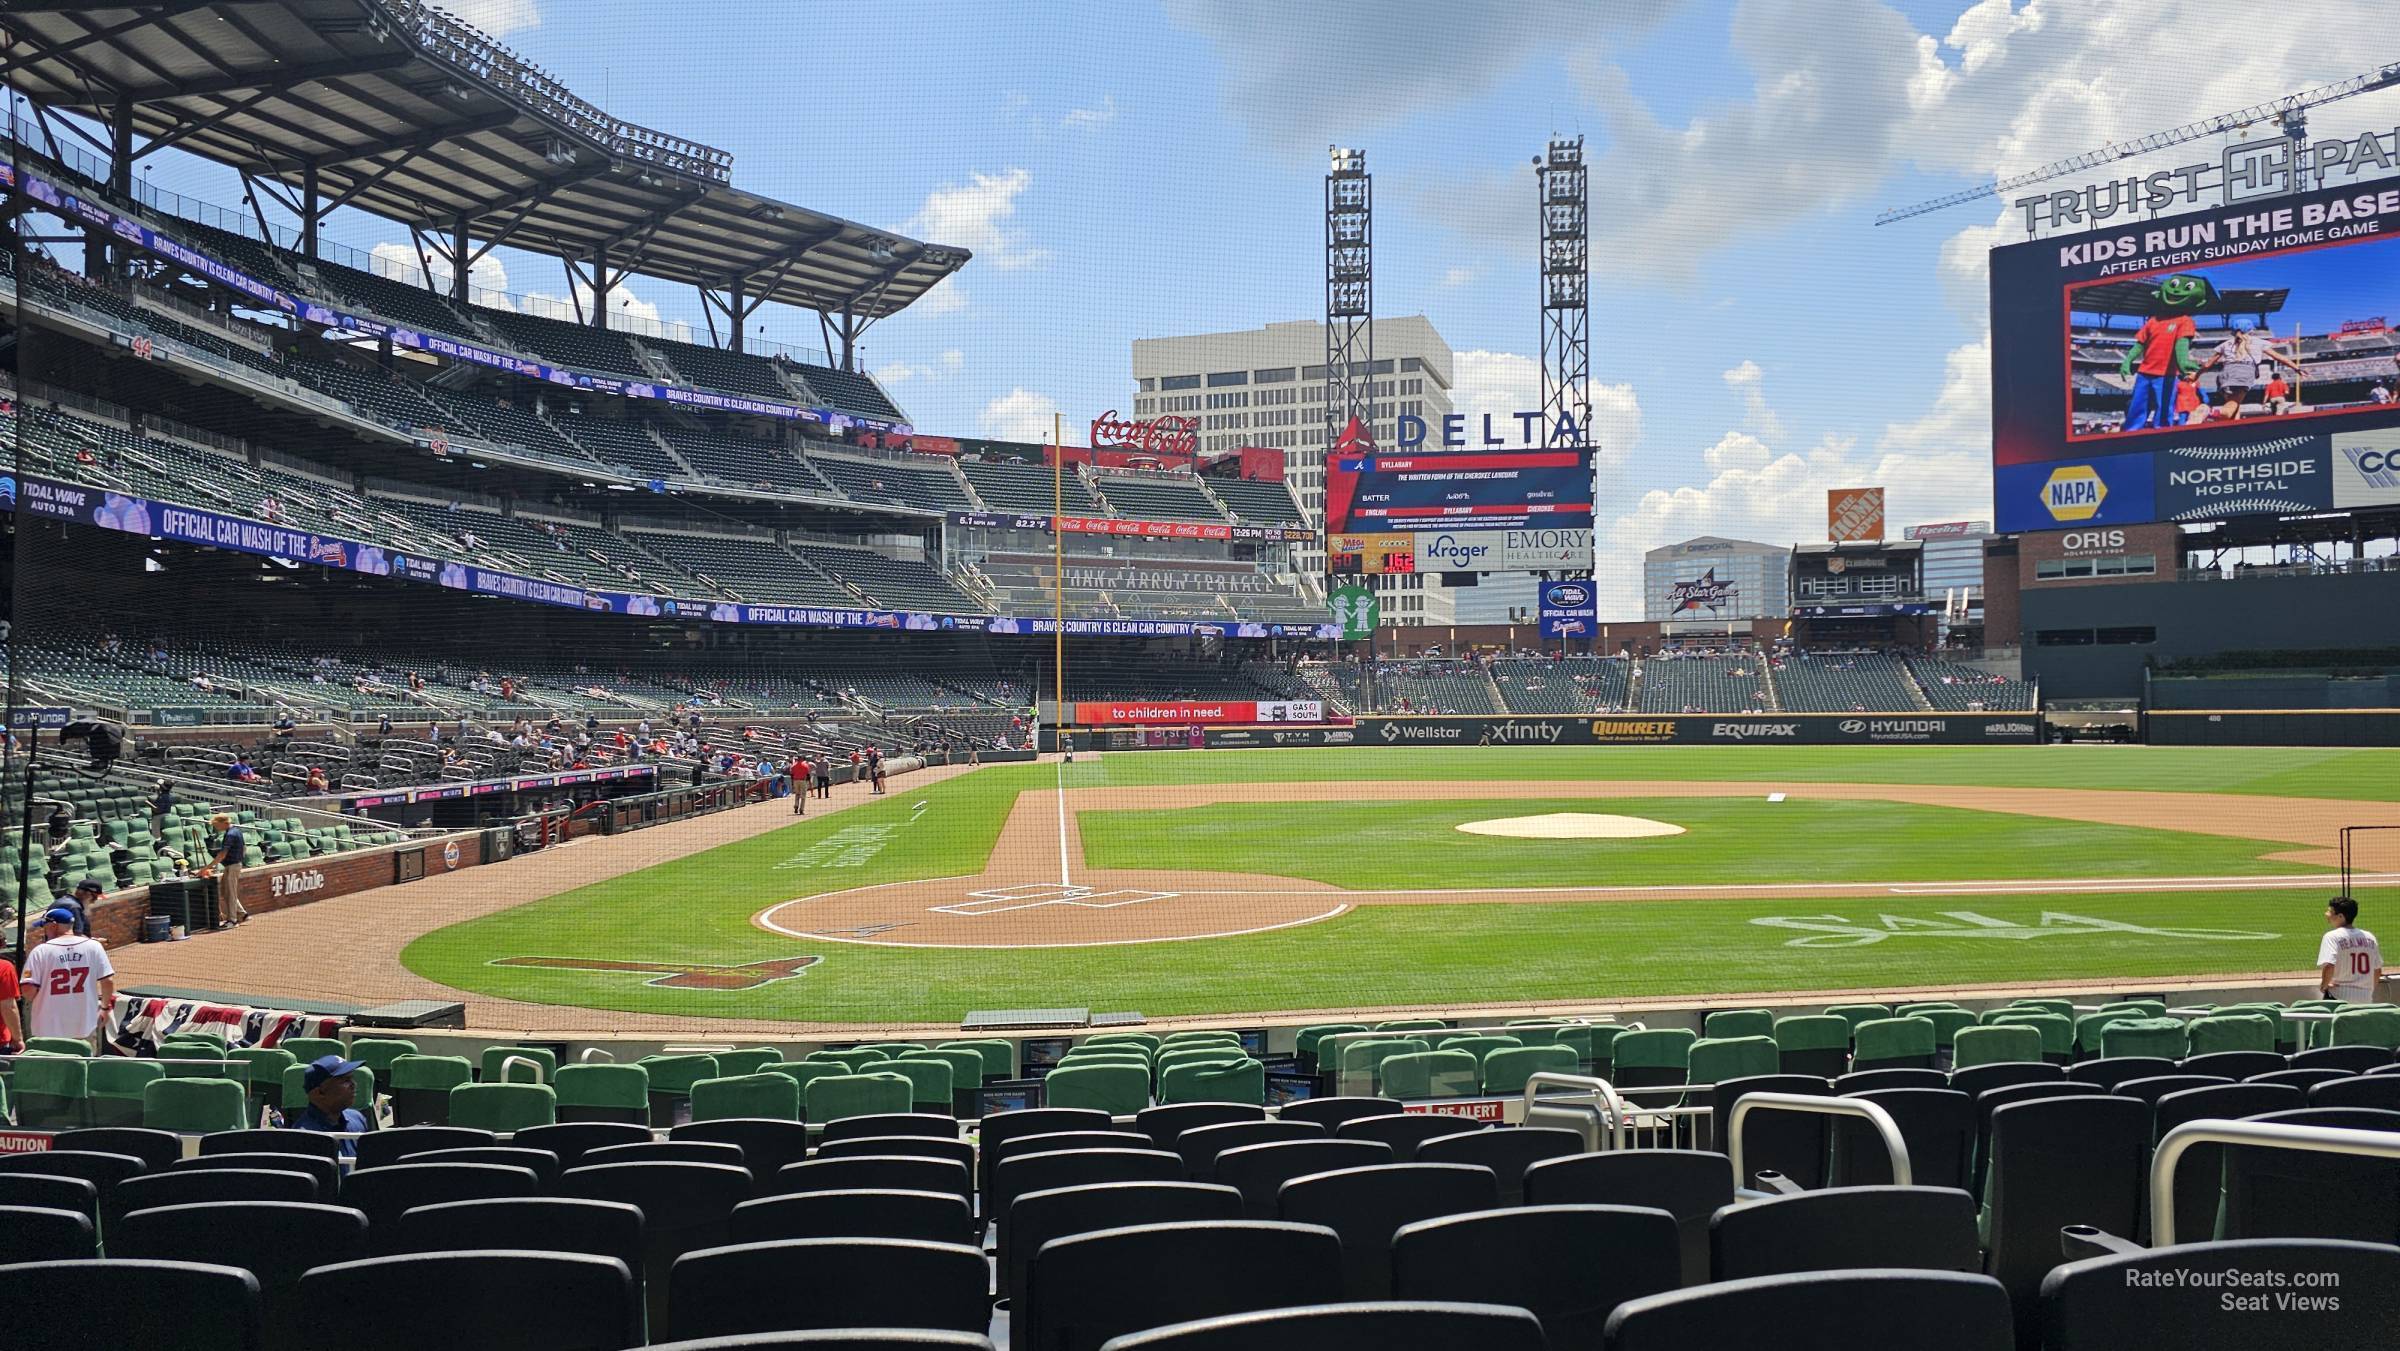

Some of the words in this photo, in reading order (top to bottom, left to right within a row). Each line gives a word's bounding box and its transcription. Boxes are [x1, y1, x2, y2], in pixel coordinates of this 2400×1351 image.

[2015, 162, 2209, 232] TRUIST
[2313, 126, 2400, 181] PA
[2060, 236, 2145, 268] KIDS
[2145, 221, 2216, 254] RUN
[2223, 207, 2293, 239] THE
[2301, 190, 2400, 225] BASE
[2100, 259, 2148, 277] AFTER
[2151, 249, 2201, 268] EVERY
[2204, 238, 2271, 259] SUNDAY
[2273, 230, 2324, 248] HOME
[2328, 220, 2380, 239] GAME
[153, 235, 180, 258] BRAVES
[180, 247, 209, 272] COUNTRY
[209, 262, 216, 276] IS
[215, 264, 235, 284] CLEAN
[235, 272, 248, 290] CAR
[247, 279, 274, 300] COUNTRY
[131, 336, 152, 360] 44
[428, 338, 459, 355] OFFICIAL
[459, 346, 473, 359] CAR
[473, 349, 492, 364] WASH
[492, 353, 502, 366] OF
[502, 356, 515, 369] THE
[666, 389, 693, 402] BRAVES
[693, 394, 723, 407] COUNTRY
[723, 397, 731, 408] IS
[731, 398, 752, 411] CLEAN
[752, 401, 766, 413] CAR
[766, 403, 794, 417] COUNTRY
[1091, 409, 1201, 455] Coca-Cola
[1397, 411, 1582, 447] DELTA
[431, 439, 448, 456] 47
[1381, 461, 1413, 469] SYLLABARY
[2169, 459, 2316, 486] NORTHSIDE
[1431, 473, 1446, 481] FORM
[1491, 471, 1518, 479] LANGUAGE
[23, 482, 54, 500] TIDAL
[55, 488, 86, 506] WAVE
[2051, 480, 2097, 506] NAPA
[2195, 480, 2288, 497] HOSPITAL
[1362, 494, 1390, 502] BATTER
[1835, 494, 1855, 514] THE
[31, 501, 56, 512] AUTO
[58, 505, 74, 516] SPA
[1443, 507, 1473, 515] SYLLABARY
[1526, 505, 1555, 513] CHEROKEE
[1829, 489, 1882, 540] HOME
[1015, 519, 1035, 528] 82.2
[1851, 508, 1884, 540] DEPOT
[1918, 523, 1963, 535] RaceTrac
[163, 509, 215, 541] OFFICIAL
[217, 520, 239, 546] CAR
[242, 525, 272, 551] WASH
[273, 530, 286, 553] OF
[288, 533, 307, 557] THE
[1233, 528, 1249, 537] 12:26
[1250, 529, 1262, 538] PM
[1507, 530, 1587, 549] EMORY
[2062, 530, 2125, 550] ORIS
[1428, 535, 1488, 567] Kroger
[1507, 550, 1584, 560] HEALTHCARE
[406, 557, 421, 569] TIDAL
[421, 561, 436, 572] WAVE
[1333, 554, 1352, 567] 50
[1389, 553, 1414, 567] 162
[477, 572, 501, 592] BRAVES
[501, 577, 527, 595] COUNTRY
[527, 581, 533, 597] IS
[533, 583, 550, 600] CLEAN
[550, 585, 561, 602] CAR
[561, 587, 583, 605] COUNTRY
[1687, 586, 1709, 599] Star
[1709, 585, 1743, 599] Game
[676, 602, 692, 610] TIDAL
[1578, 609, 1594, 617] WASH
[749, 608, 788, 622] OFFICIAL
[789, 609, 806, 623] CAR
[808, 609, 833, 624] WASH
[834, 611, 845, 624] OF
[845, 612, 863, 625] THE
[969, 618, 985, 626] WAVE
[1066, 621, 1102, 633] COUNTRY
[1103, 622, 1111, 633] IS
[1112, 622, 1138, 633] CLEAN
[1139, 622, 1154, 634] CAR
[1155, 623, 1190, 635] COUNTRY
[1112, 708, 1126, 718] to
[1128, 706, 1178, 719] children
[1180, 707, 1190, 718] in
[1193, 706, 1225, 718] need.
[1293, 711, 1318, 719] SOUTH
[1403, 726, 1462, 739] Wellstar
[1491, 720, 1563, 743] xfinity
[1592, 721, 1676, 736] QUIKRETE
[1712, 723, 1796, 739] EQUIFAX
[1870, 720, 1946, 733] HYUNDAI
[59, 952, 84, 964] RILEY
[2349, 952, 2371, 975] 10
[50, 966, 90, 996] 27
[1459, 1104, 1498, 1118] ALERT
